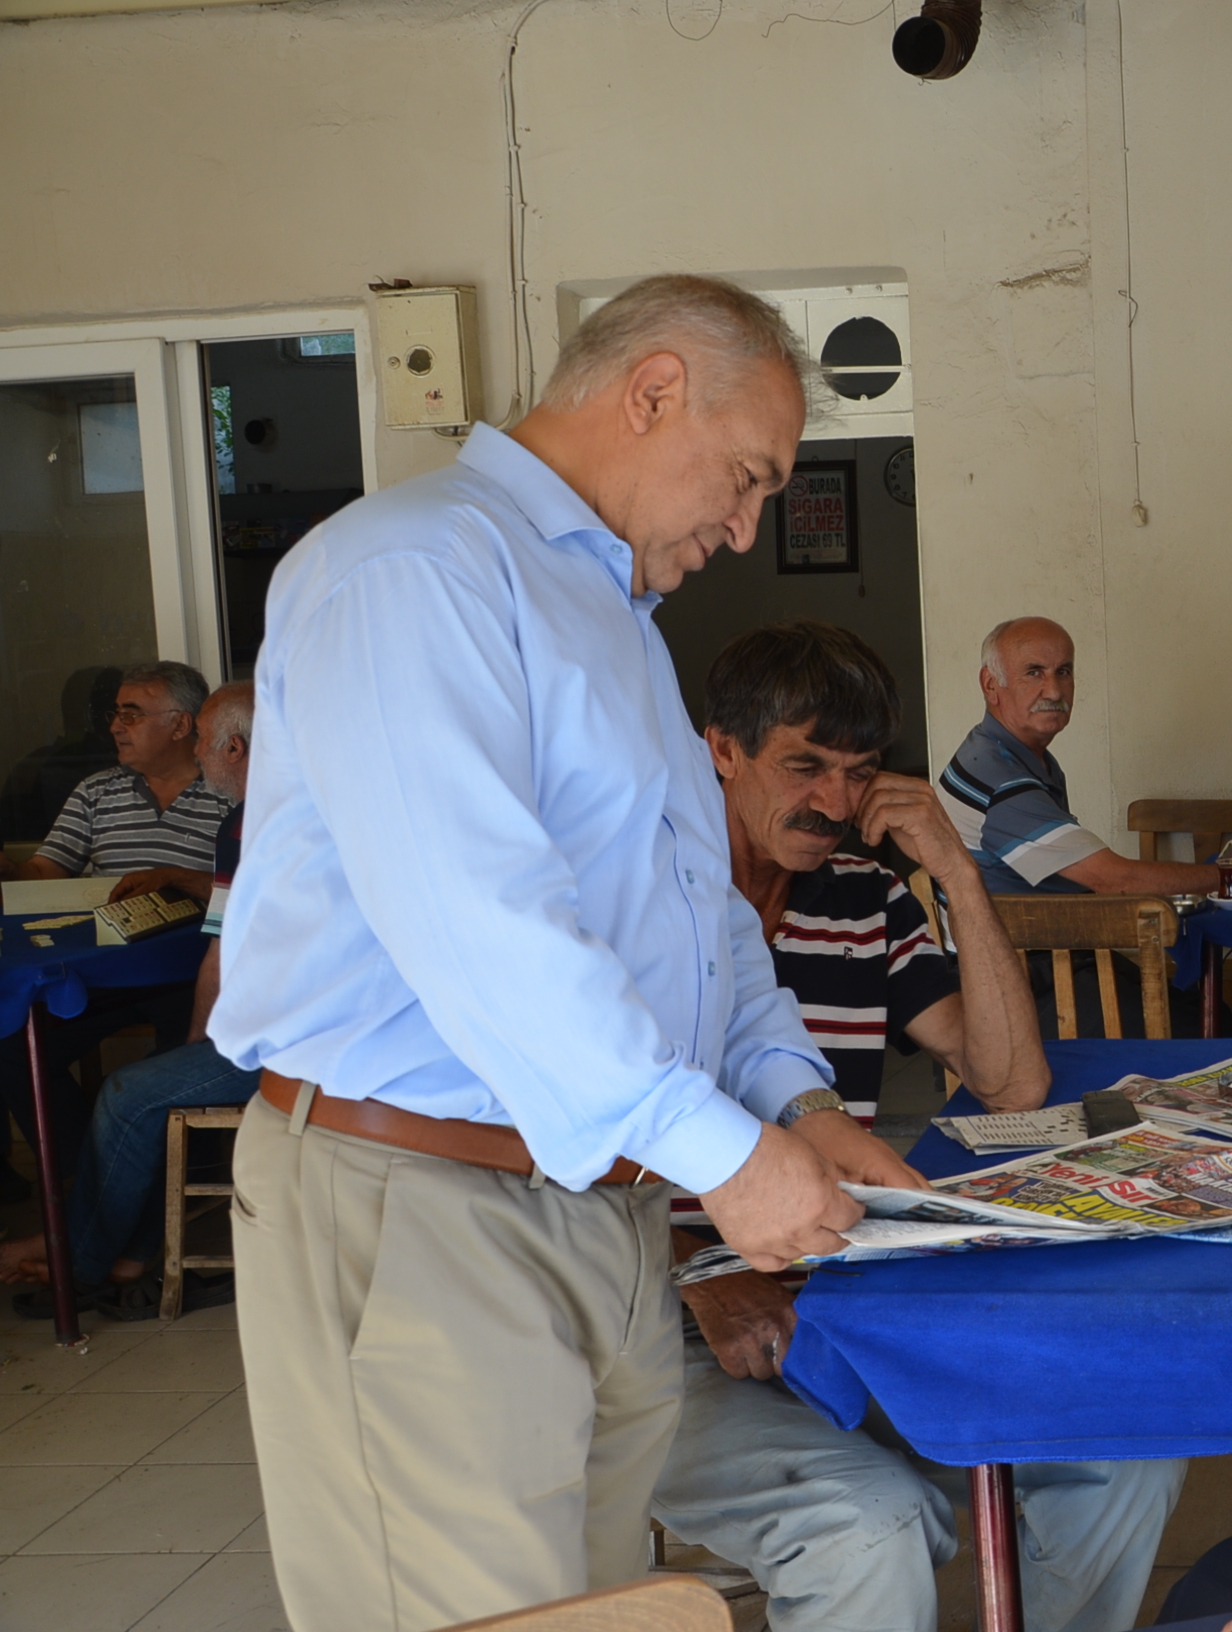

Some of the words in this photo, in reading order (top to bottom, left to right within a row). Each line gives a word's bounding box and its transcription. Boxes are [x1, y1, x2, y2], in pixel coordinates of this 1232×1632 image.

[809, 477, 842, 495] BURADA
[789, 533, 820, 549] CEZASI
[835, 532, 846, 548] TL
[1040, 1163, 1110, 1185] Yeni
